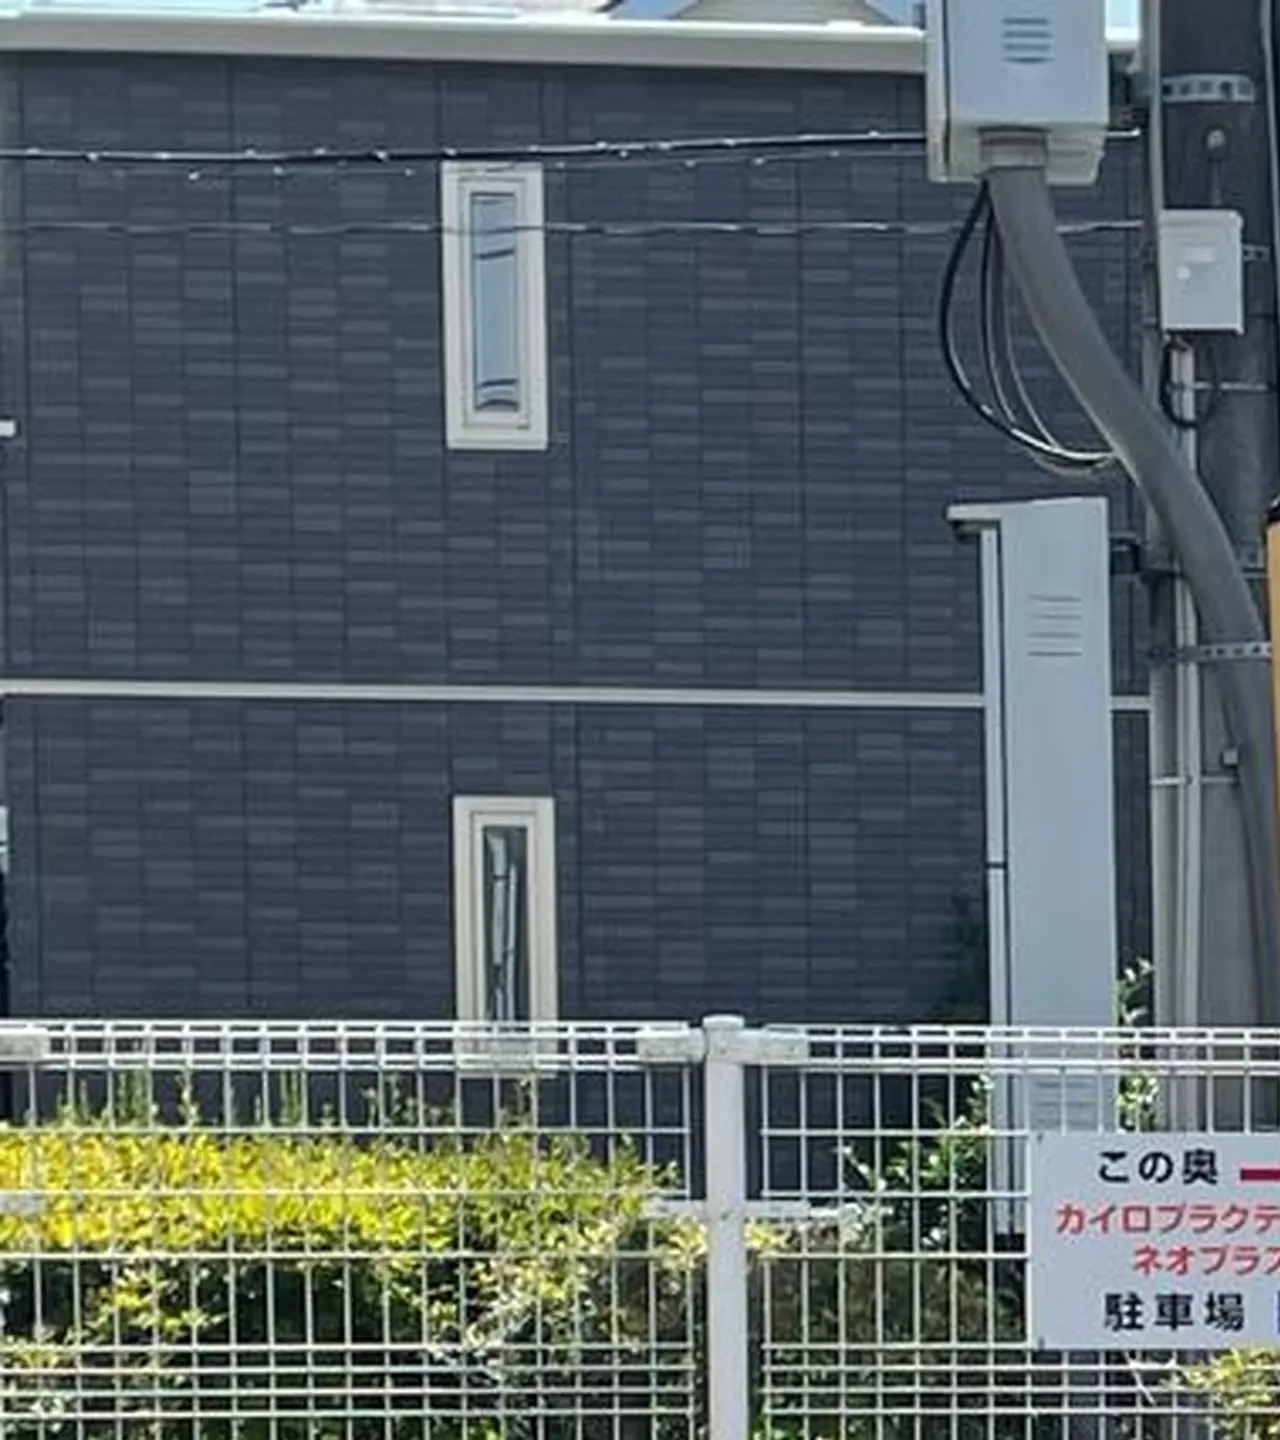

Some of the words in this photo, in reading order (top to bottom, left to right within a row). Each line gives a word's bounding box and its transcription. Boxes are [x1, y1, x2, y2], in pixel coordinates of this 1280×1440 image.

[1097, 1148, 1219, 1185] この奥
[1104, 1292, 1244, 1332] 駐車場
